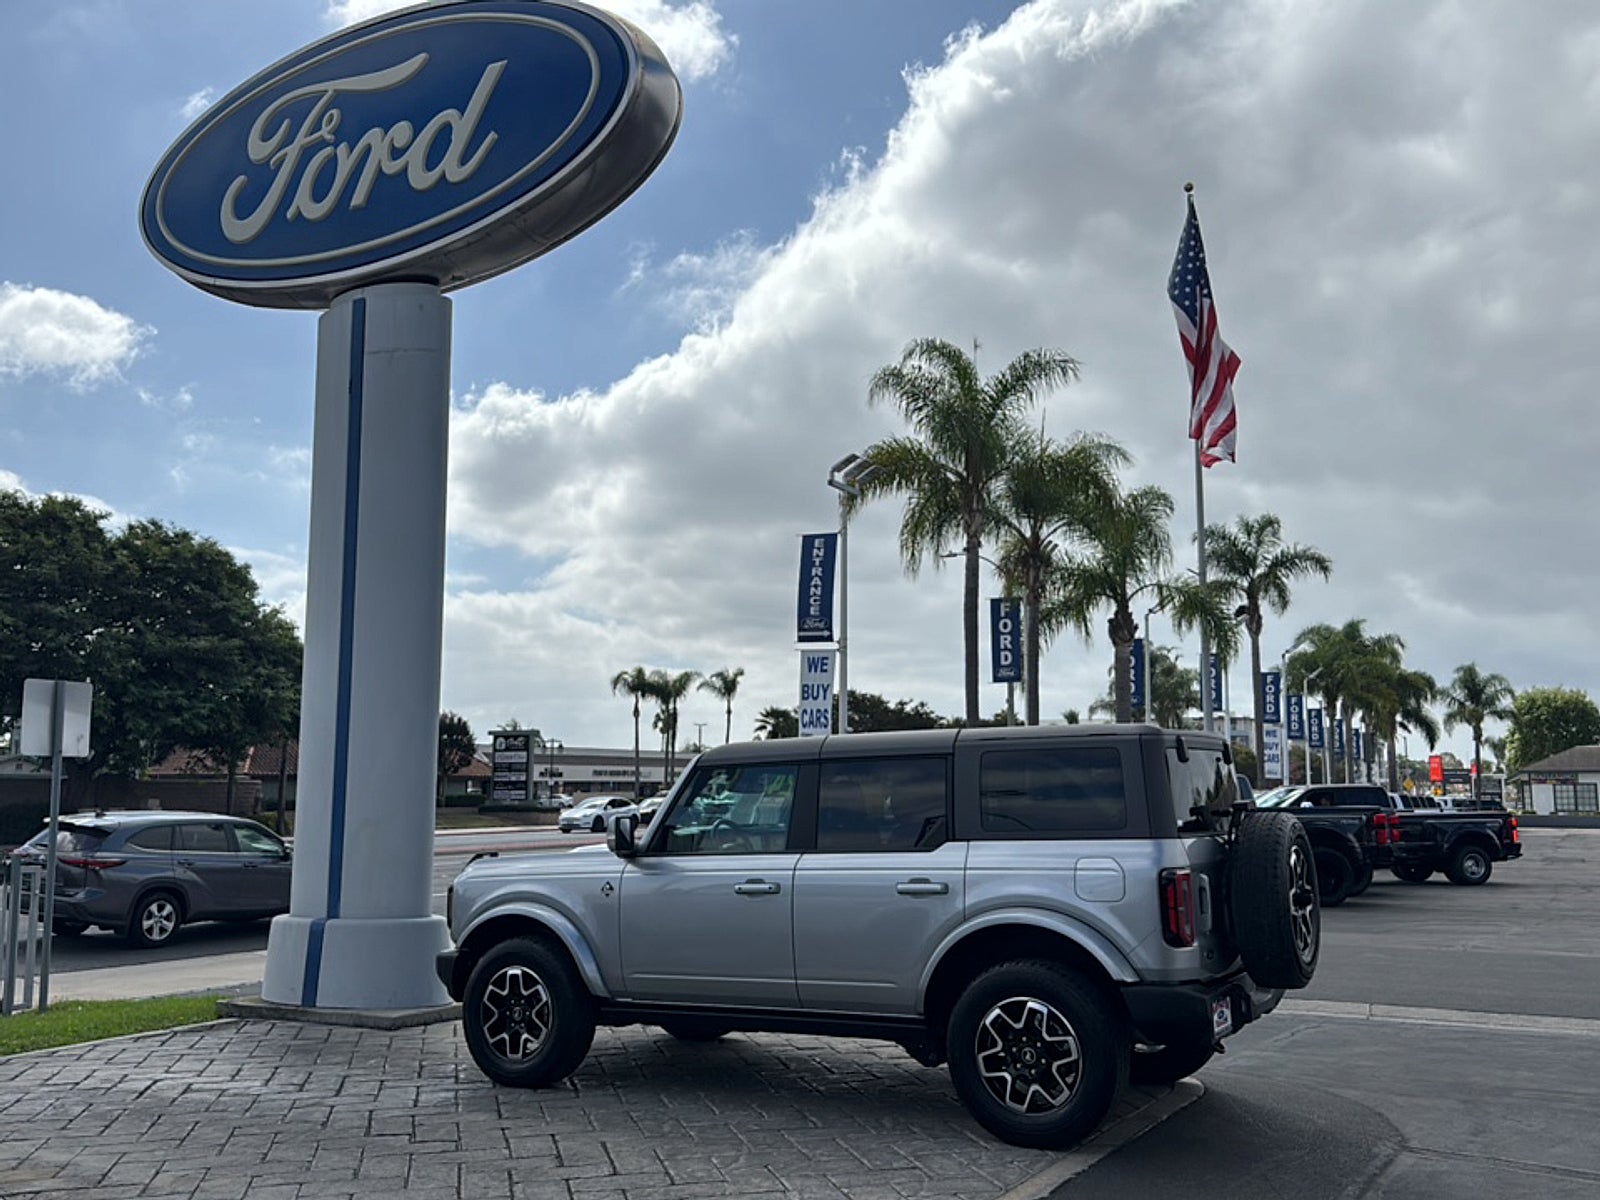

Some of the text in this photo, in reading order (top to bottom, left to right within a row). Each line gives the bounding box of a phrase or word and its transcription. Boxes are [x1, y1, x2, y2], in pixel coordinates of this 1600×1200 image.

[220, 52, 507, 245] Ford
[809, 538, 825, 616] ENTRANCE
[998, 601, 1013, 665] FORD
[807, 656, 829, 673] WE
[802, 684, 830, 701] BUY
[1265, 675, 1275, 713] FORD
[801, 708, 830, 729] CARS
[1290, 697, 1300, 730] FORD
